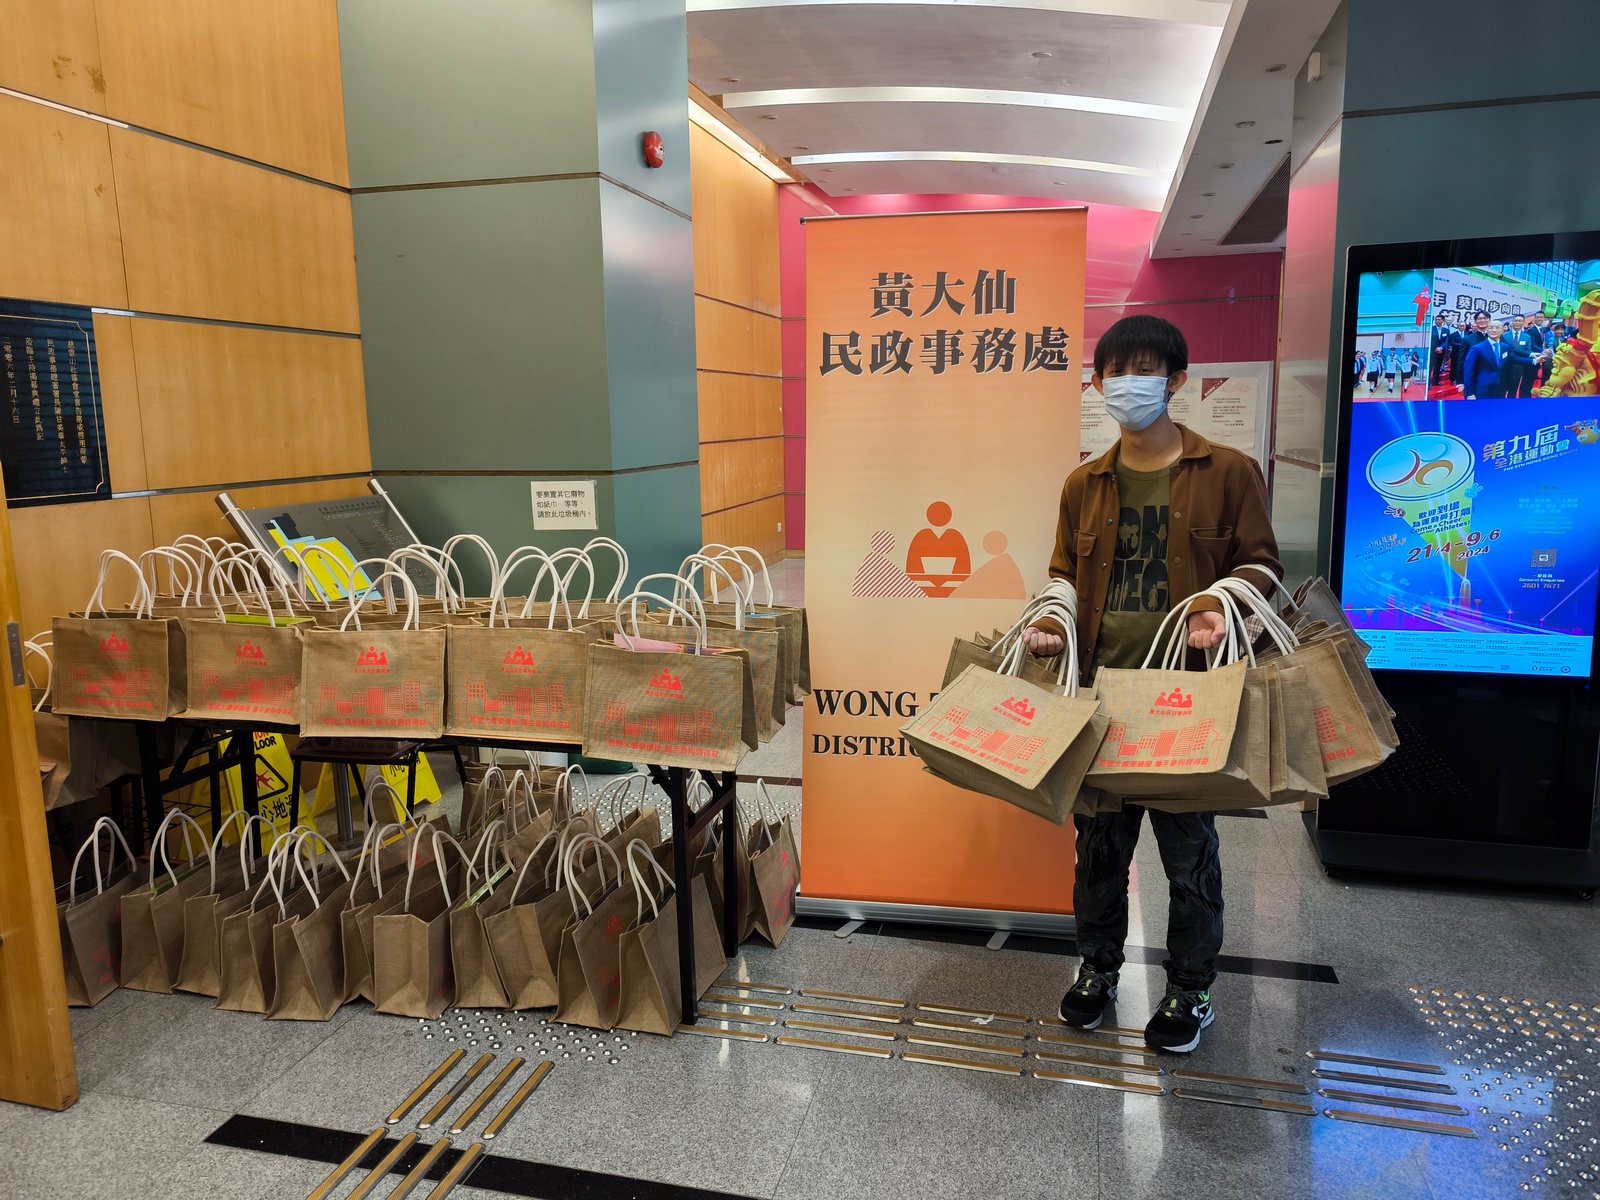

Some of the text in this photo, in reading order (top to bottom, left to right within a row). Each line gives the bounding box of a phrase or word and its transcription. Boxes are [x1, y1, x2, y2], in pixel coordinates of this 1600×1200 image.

[869, 269, 1017, 319] 黃大仙
[819, 326, 1070, 377] 民政事務處
[1482, 424, 1559, 463] 第九屆
[1494, 439, 1570, 470] 全港運動會
[1410, 524, 1433, 535] Come
[1438, 517, 1461, 527] Cheer
[1435, 520, 1470, 534] Athletes!
[1456, 545, 1490, 562] 2024
[812, 688, 920, 718] WONG
[253, 735, 277, 751] LOOR
